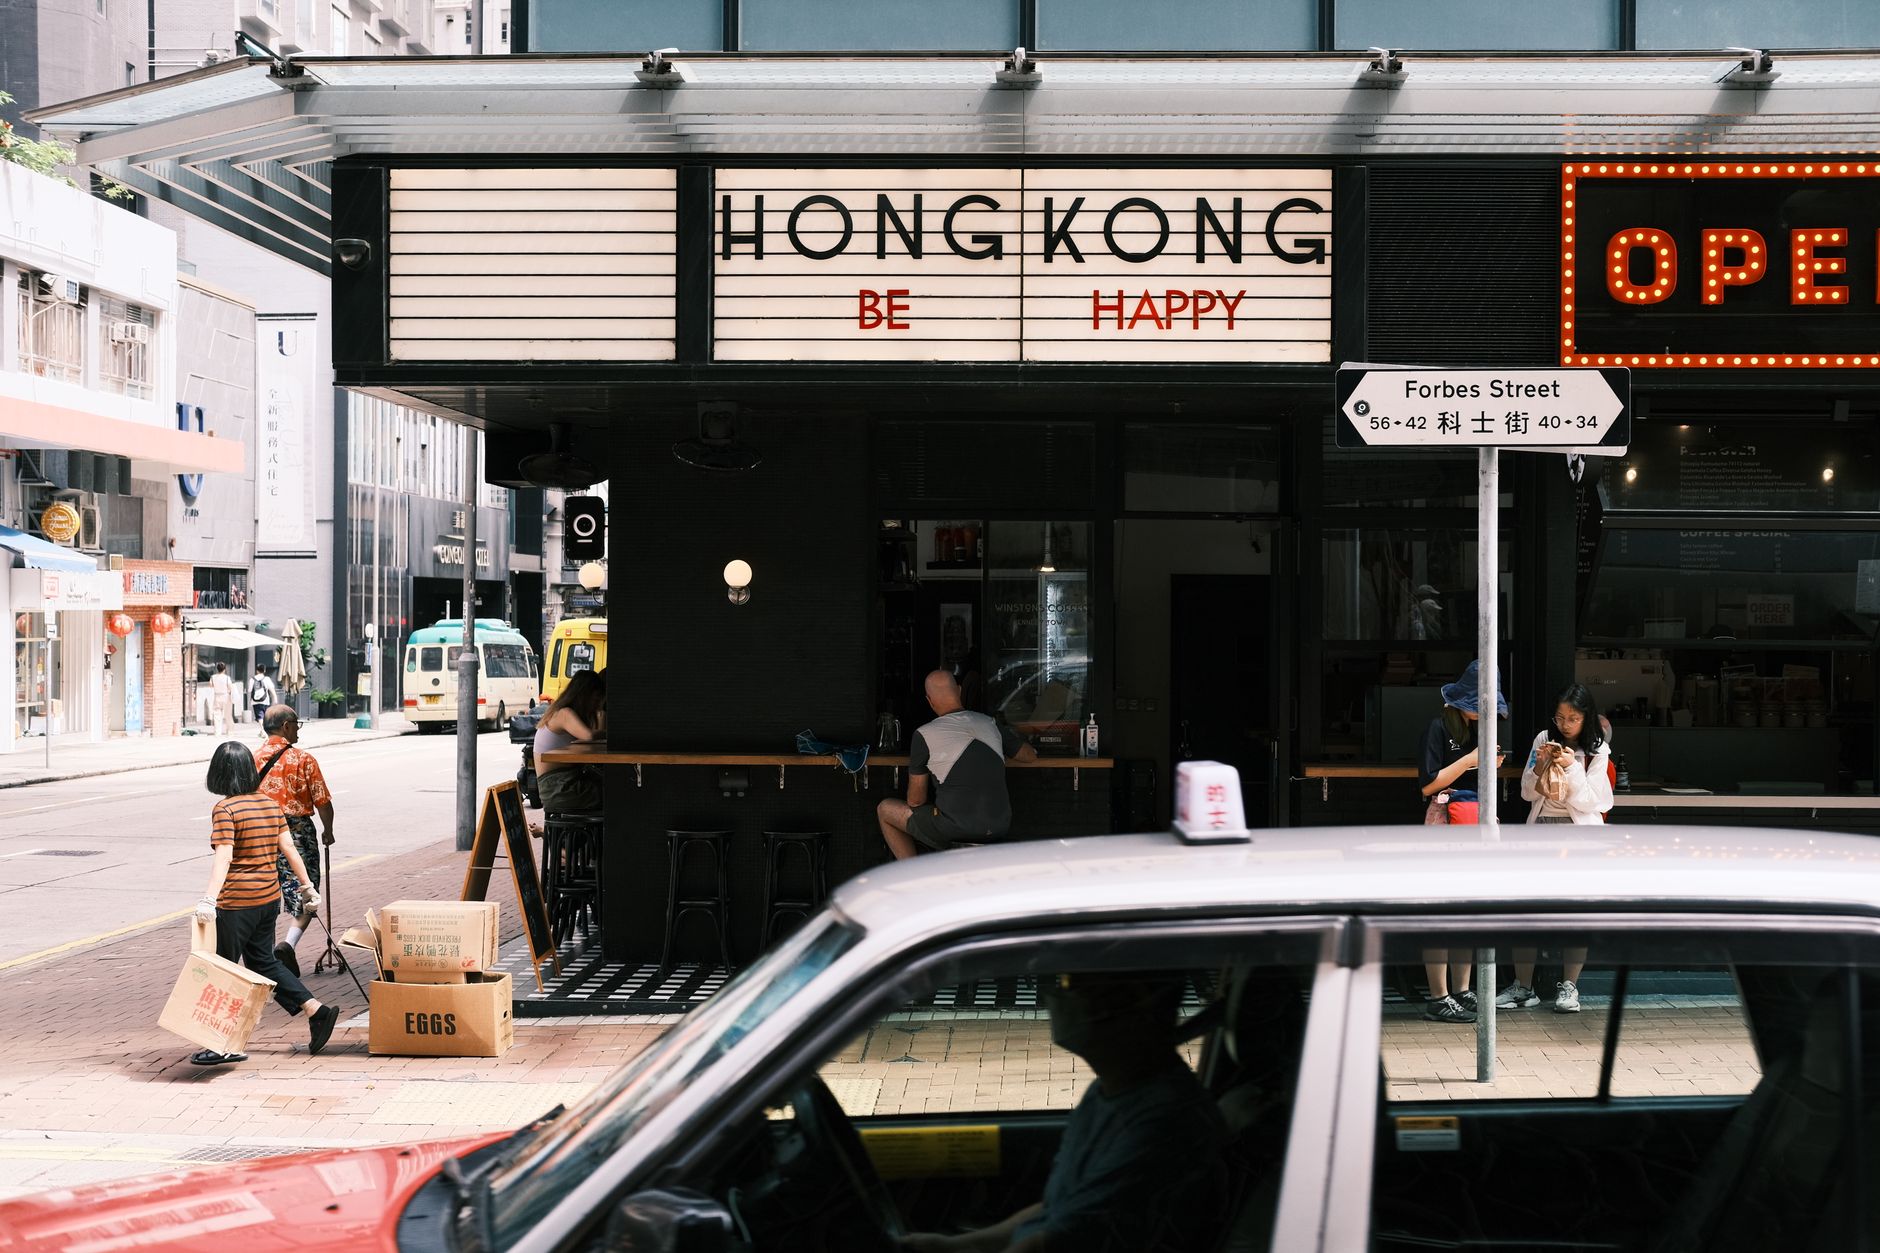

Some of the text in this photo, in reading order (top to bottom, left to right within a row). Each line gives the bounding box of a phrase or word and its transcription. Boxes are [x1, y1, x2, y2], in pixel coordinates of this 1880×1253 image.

[722, 194, 1325, 264] HONG KONG
[1606, 227, 1880, 304] OPE
[858, 289, 1247, 331] BE HAPPY
[277, 330, 298, 357] U
[1405, 379, 1560, 398] Forbes Street
[1370, 411, 1598, 434] 56 42 科士街 40 34
[1750, 603, 1791, 613] ORDER
[1754, 614, 1786, 624] HERE
[192, 1009, 222, 1031] FRESH
[405, 1012, 456, 1035] EGGS
